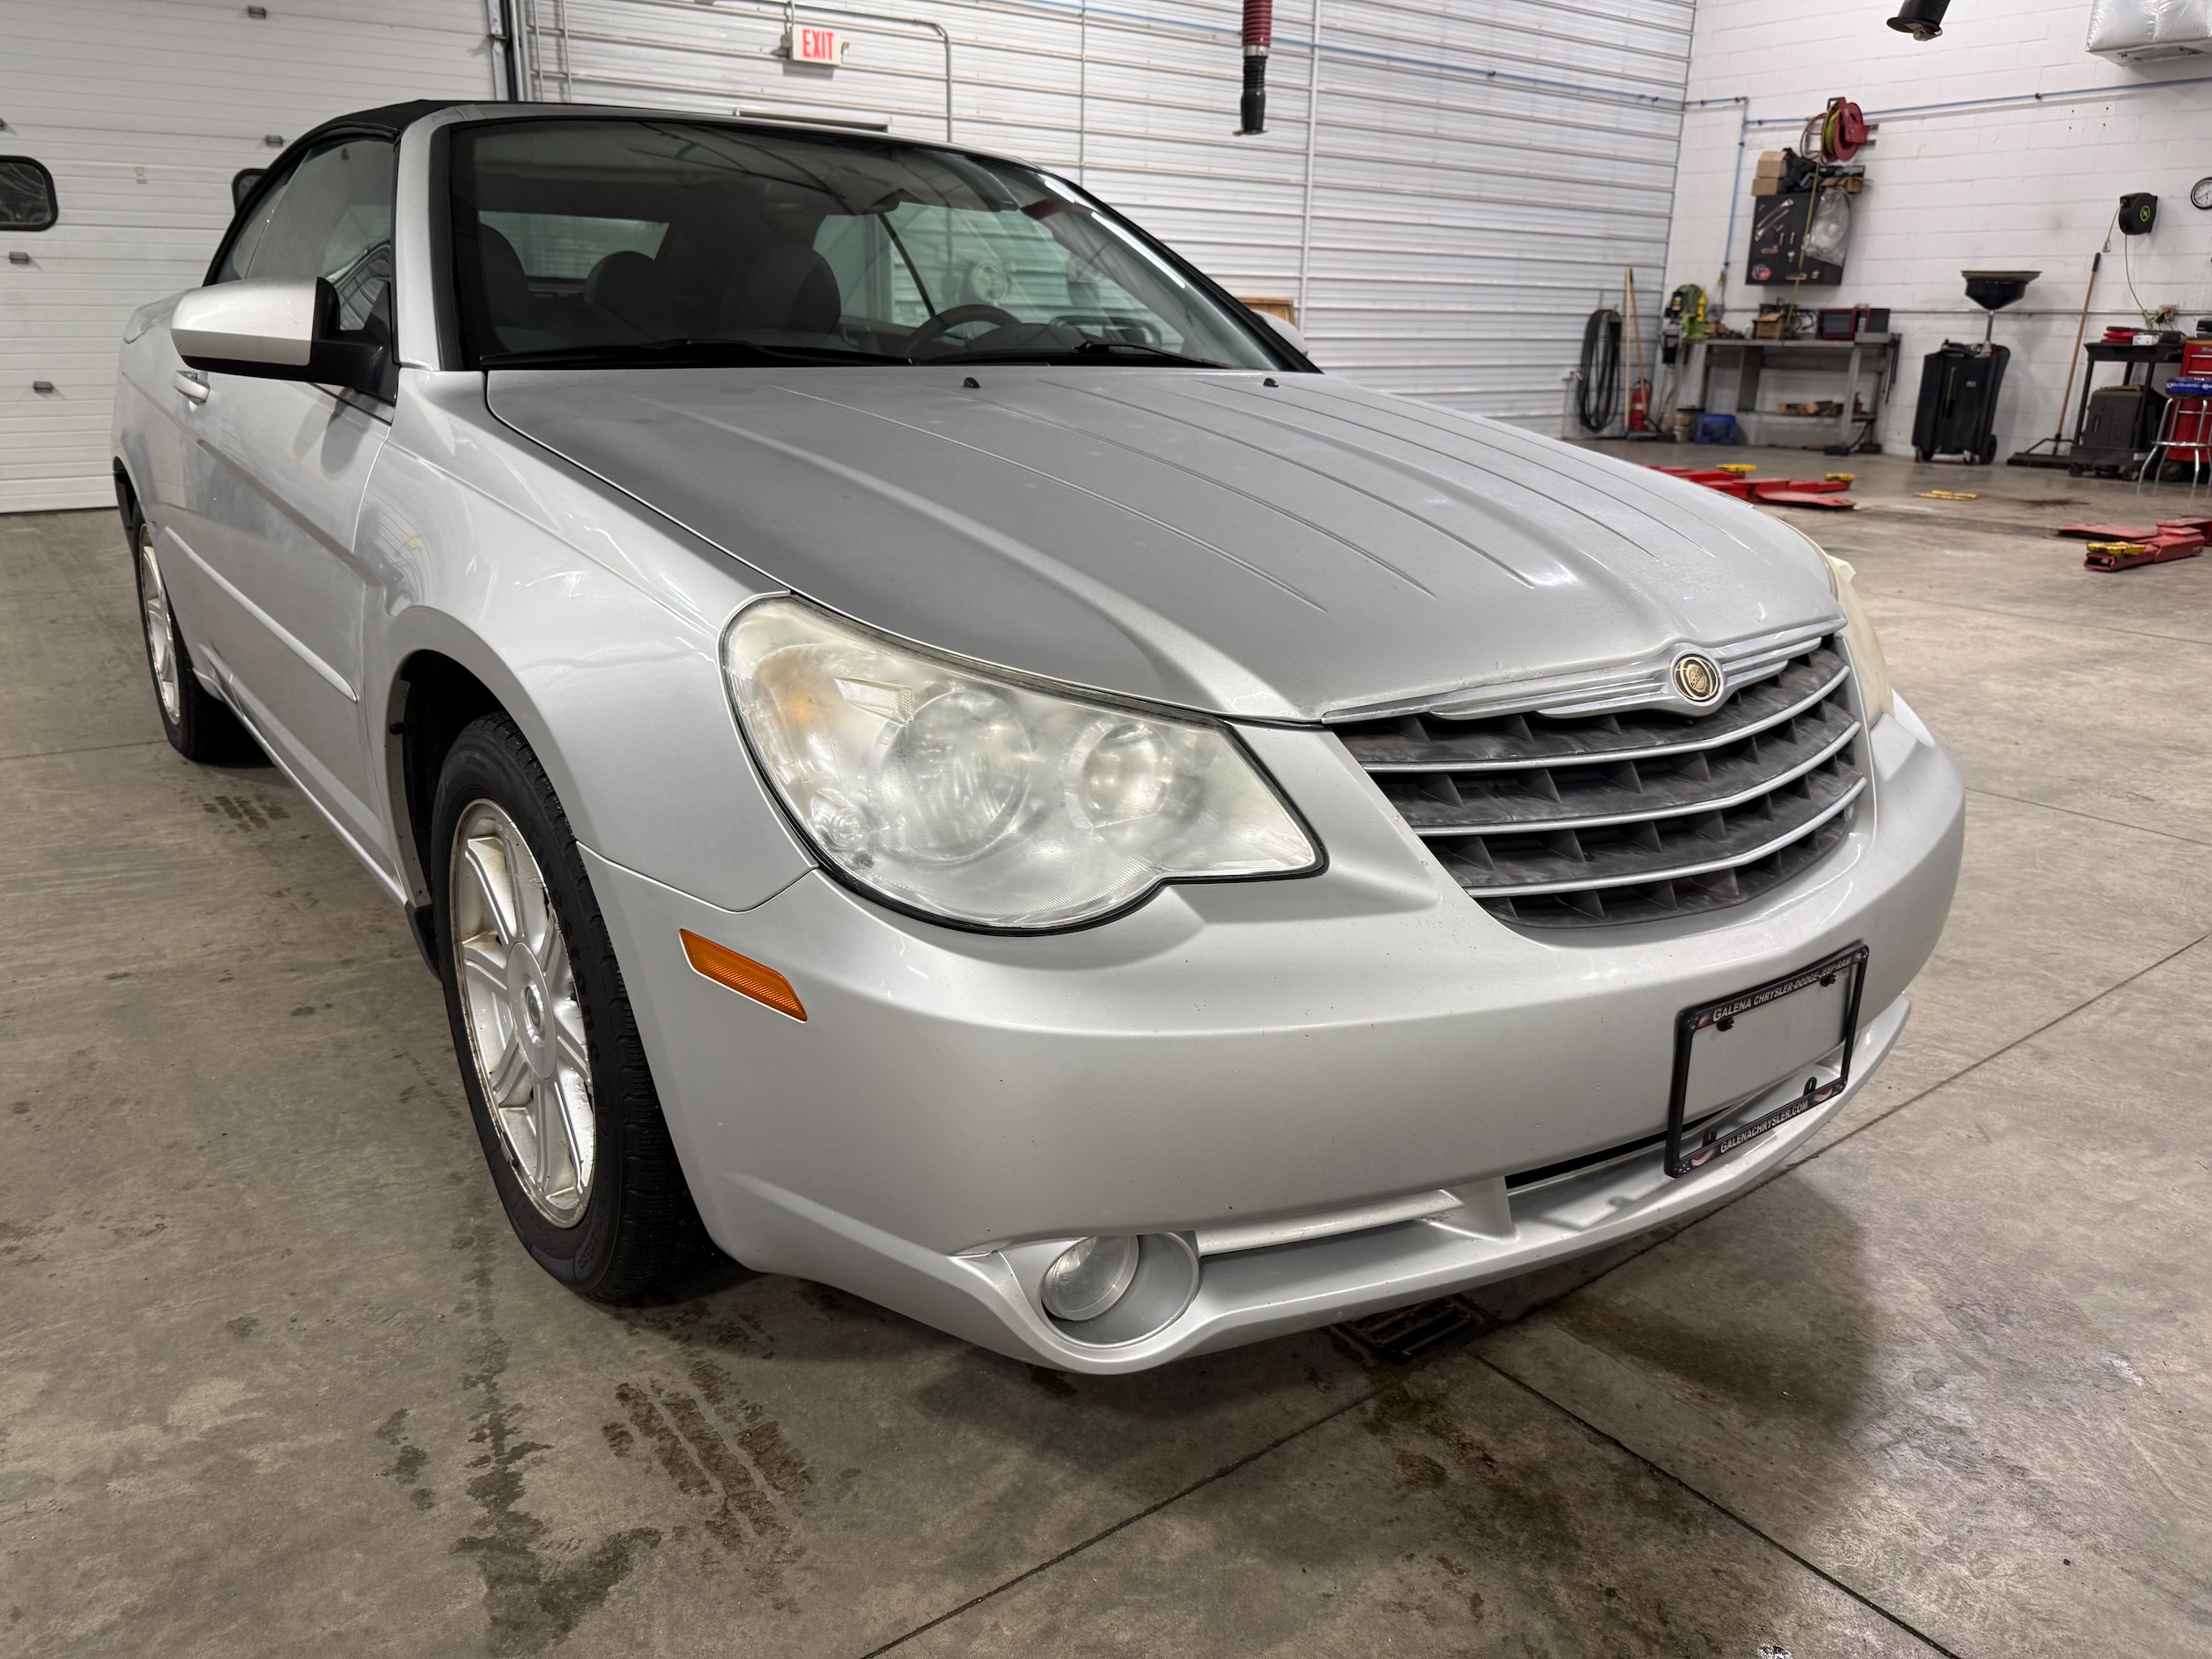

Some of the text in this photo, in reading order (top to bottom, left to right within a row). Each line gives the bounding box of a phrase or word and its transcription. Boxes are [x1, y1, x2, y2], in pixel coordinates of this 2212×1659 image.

[803, 28, 834, 60] EXIT
[1712, 999, 1751, 1022] GALENA
[1720, 1100, 1809, 1154] GALENACHRYSLER.COM
